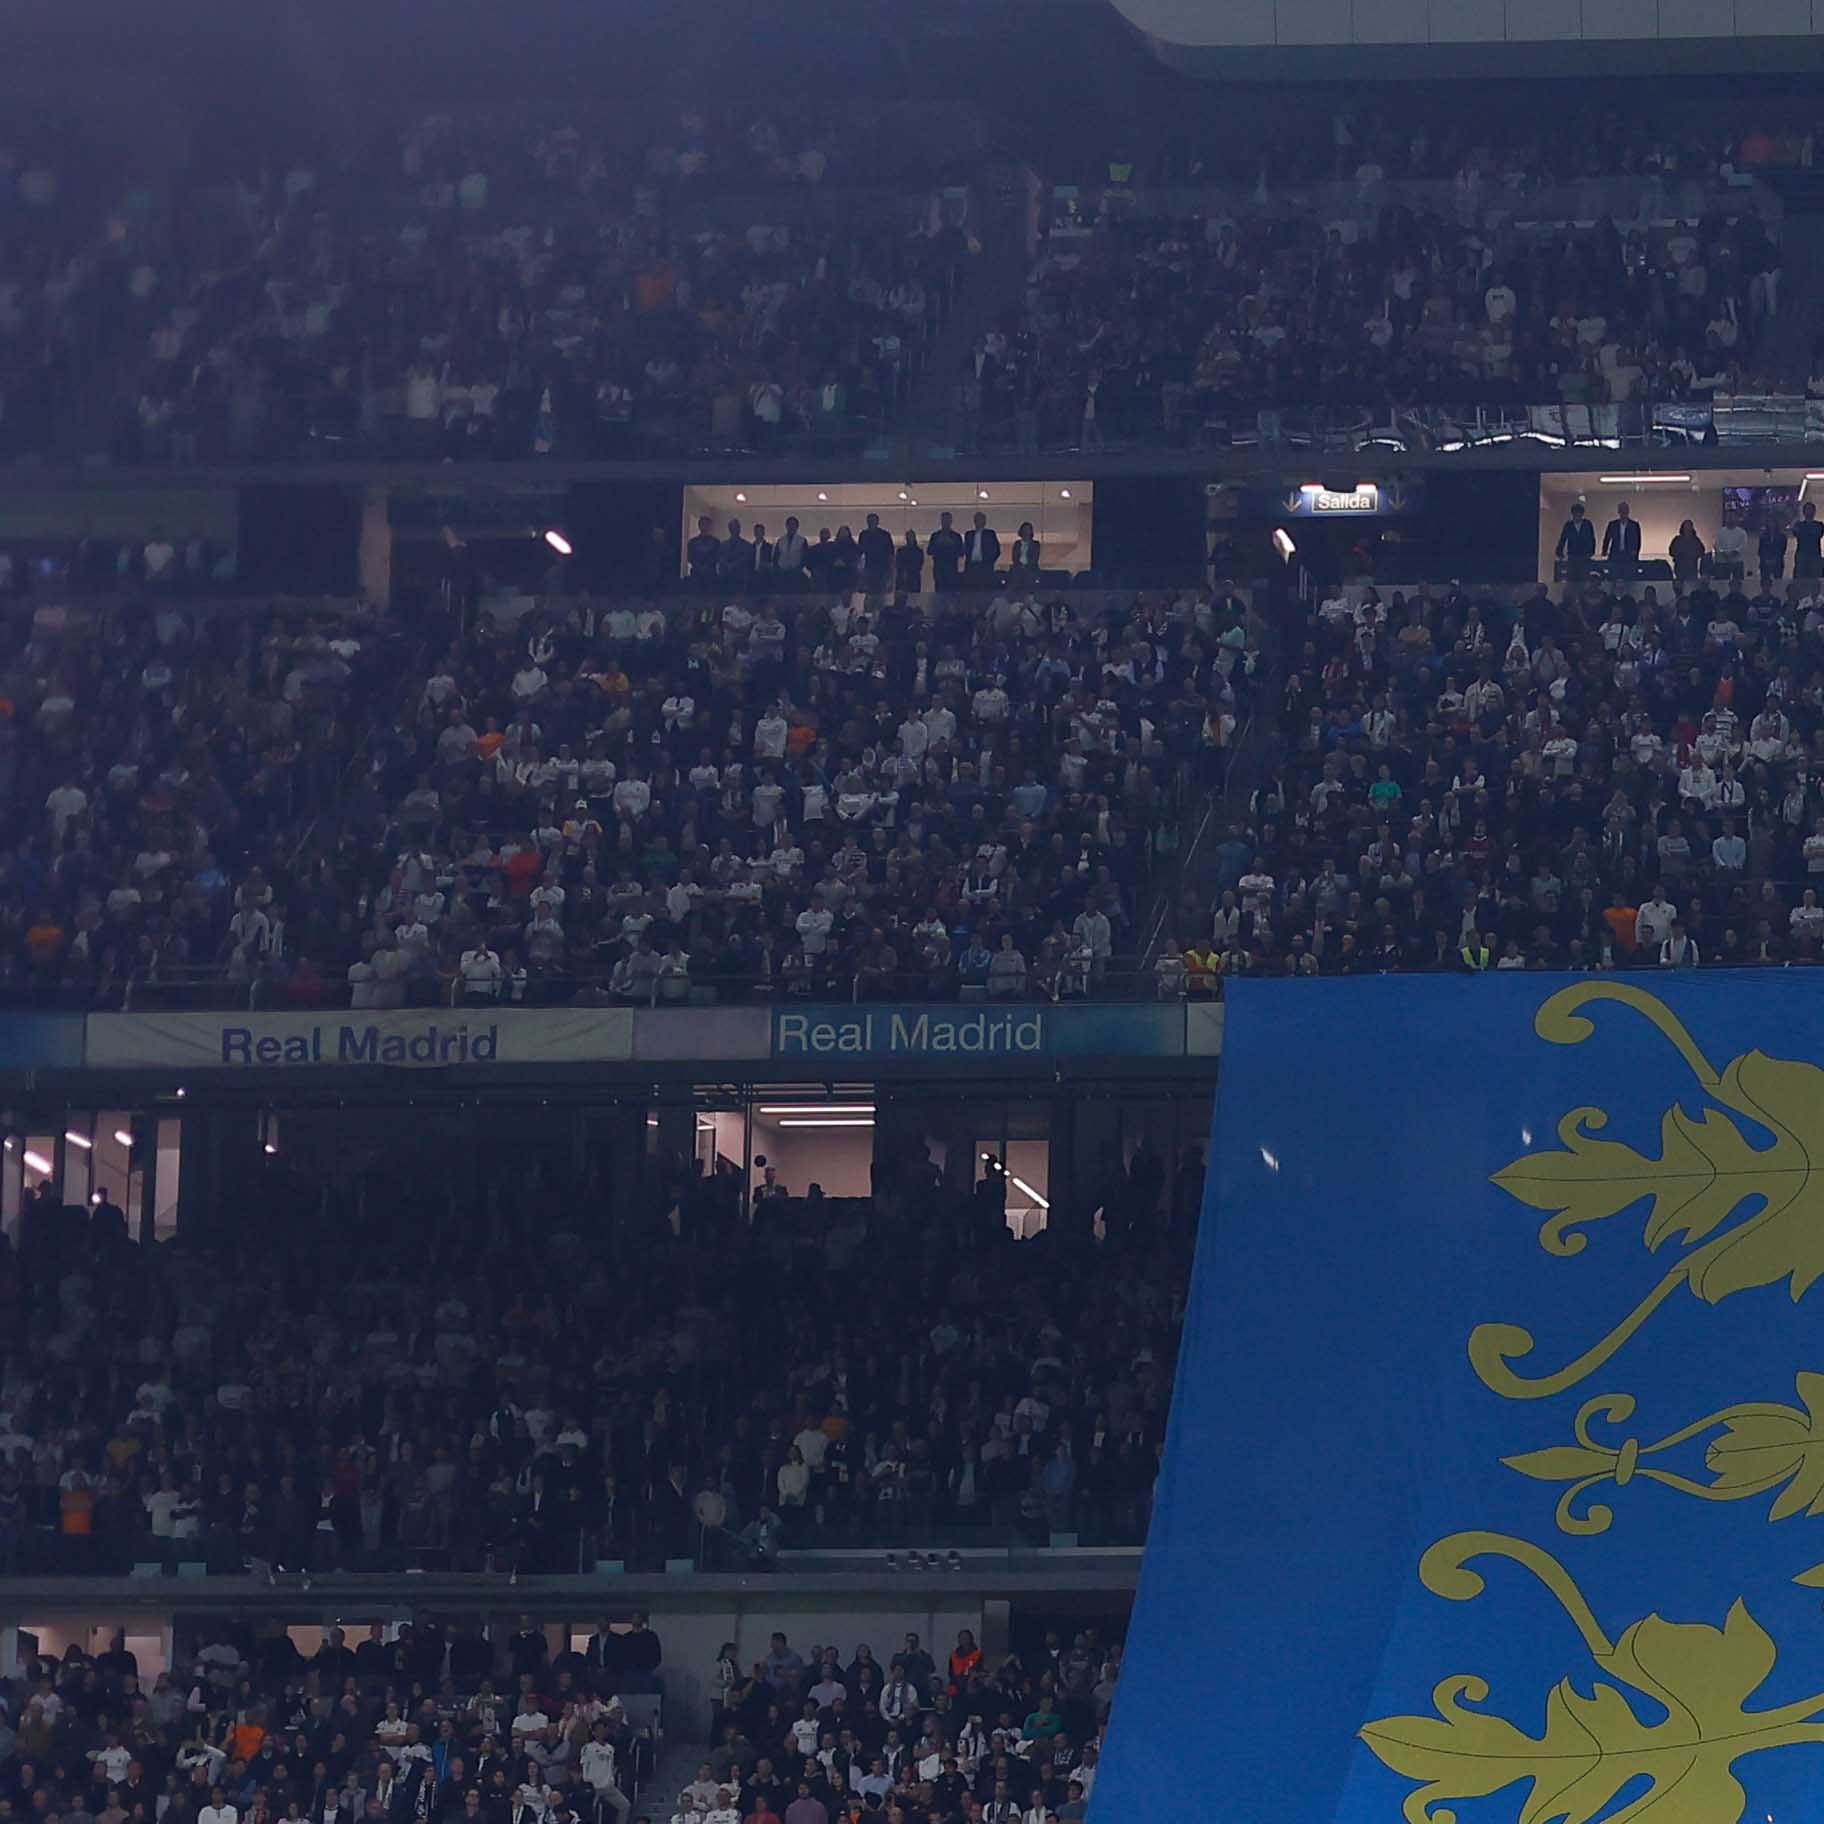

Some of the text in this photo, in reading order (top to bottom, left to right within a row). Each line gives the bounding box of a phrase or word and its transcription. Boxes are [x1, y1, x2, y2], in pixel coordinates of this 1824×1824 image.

[1318, 493, 1371, 509] Salida
[221, 1025, 498, 1064] Real Madrid
[778, 1012, 1042, 1051] Real Madrid
